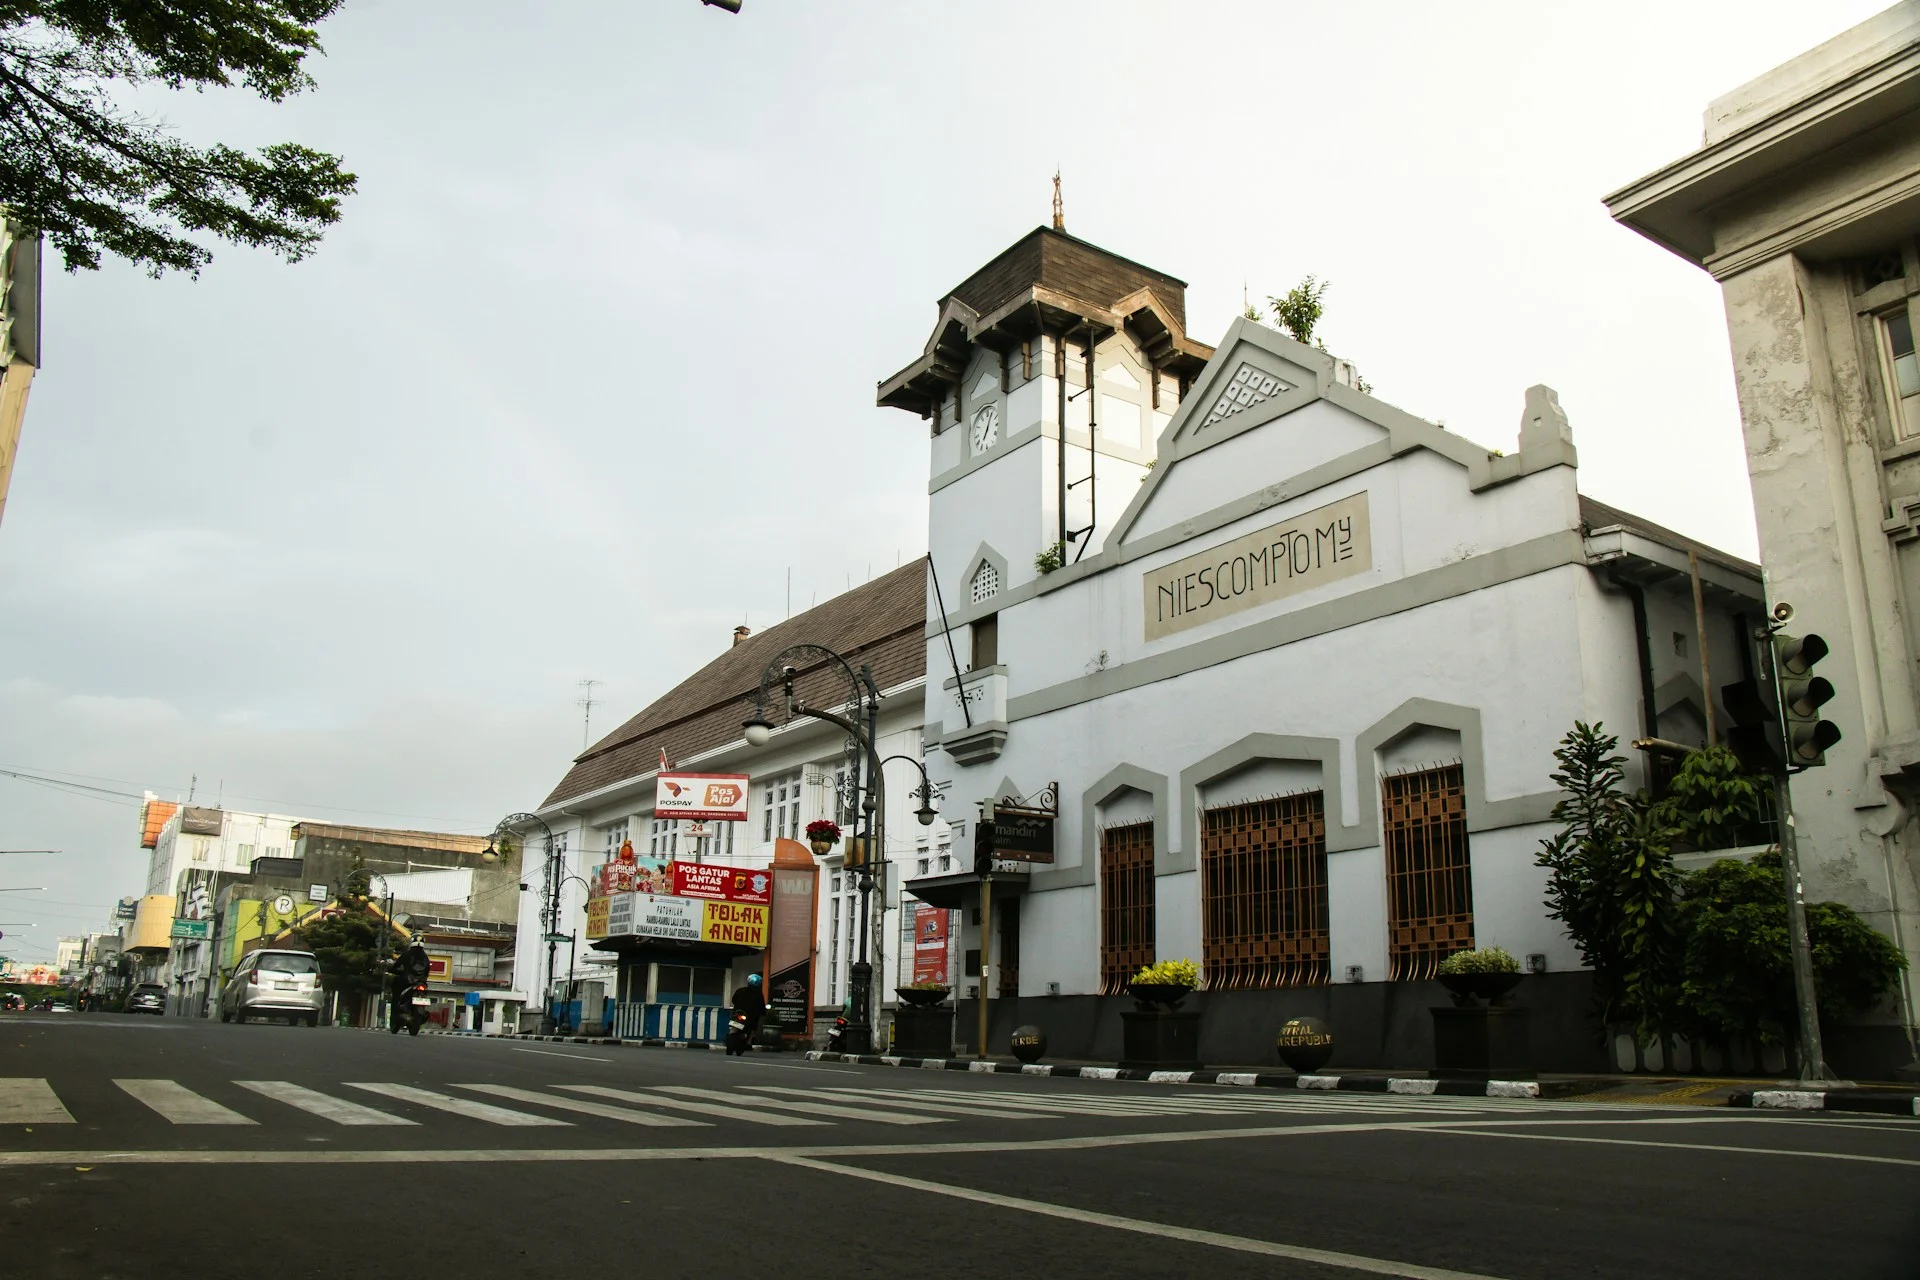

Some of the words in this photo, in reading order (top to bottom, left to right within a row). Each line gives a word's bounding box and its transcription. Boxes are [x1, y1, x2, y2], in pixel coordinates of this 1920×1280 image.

[710, 785, 733, 795] Pos
[710, 794, 735, 805] Aja!
[691, 824, 704, 832] 24
[995, 825, 1036, 838] mandiri
[679, 865, 697, 874] POS
[699, 868, 730, 878] GATUR
[686, 874, 722, 885] LANTAS
[708, 903, 763, 925] TOLAK
[708, 923, 762, 943] ANGIN
